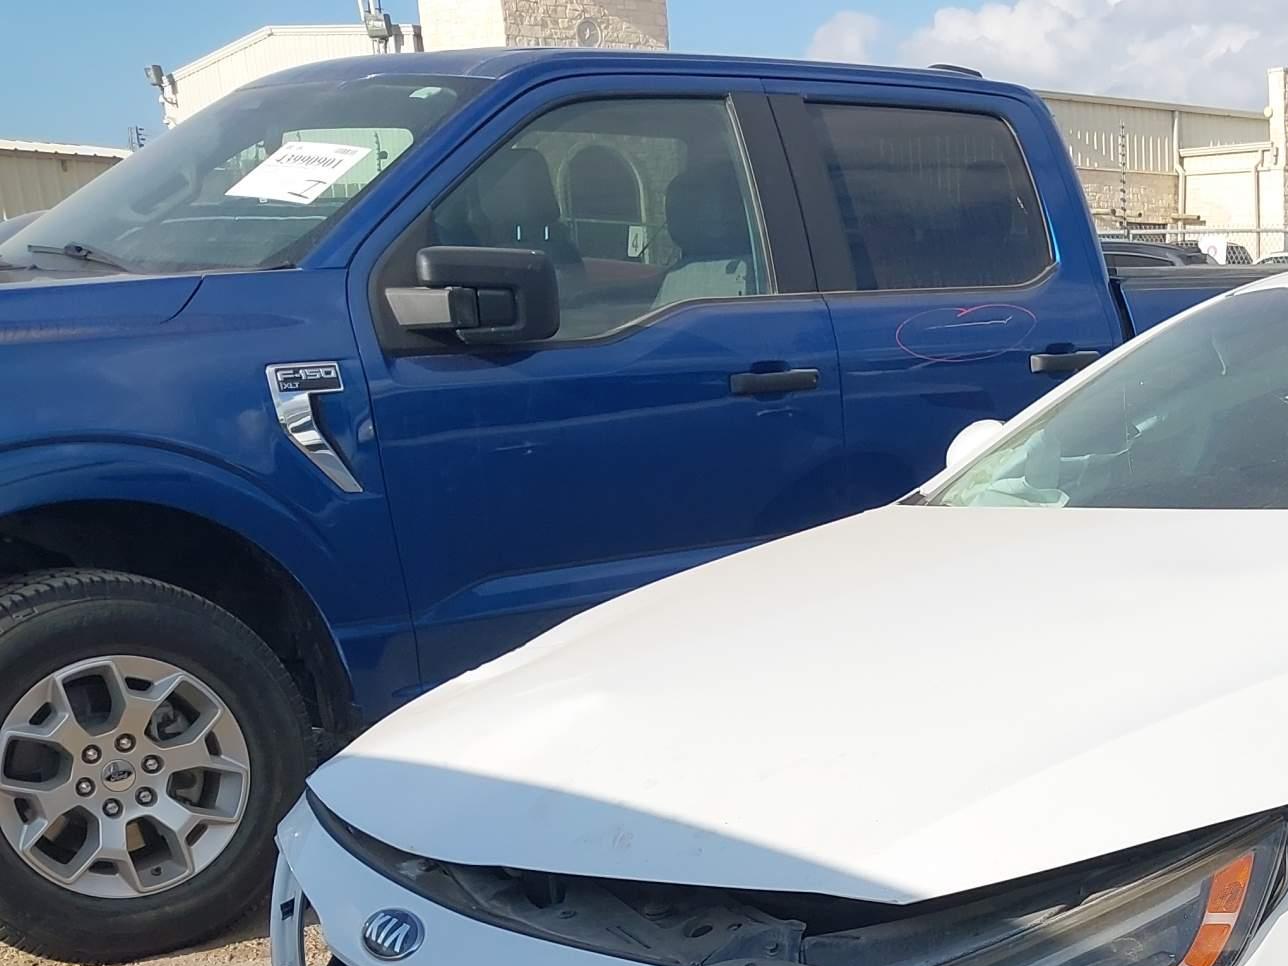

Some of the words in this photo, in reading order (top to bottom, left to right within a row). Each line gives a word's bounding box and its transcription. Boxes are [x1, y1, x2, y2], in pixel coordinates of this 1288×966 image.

[277, 366, 337, 381] F-150
[282, 382, 300, 390] XLT
[365, 912, 411, 953] KIA
